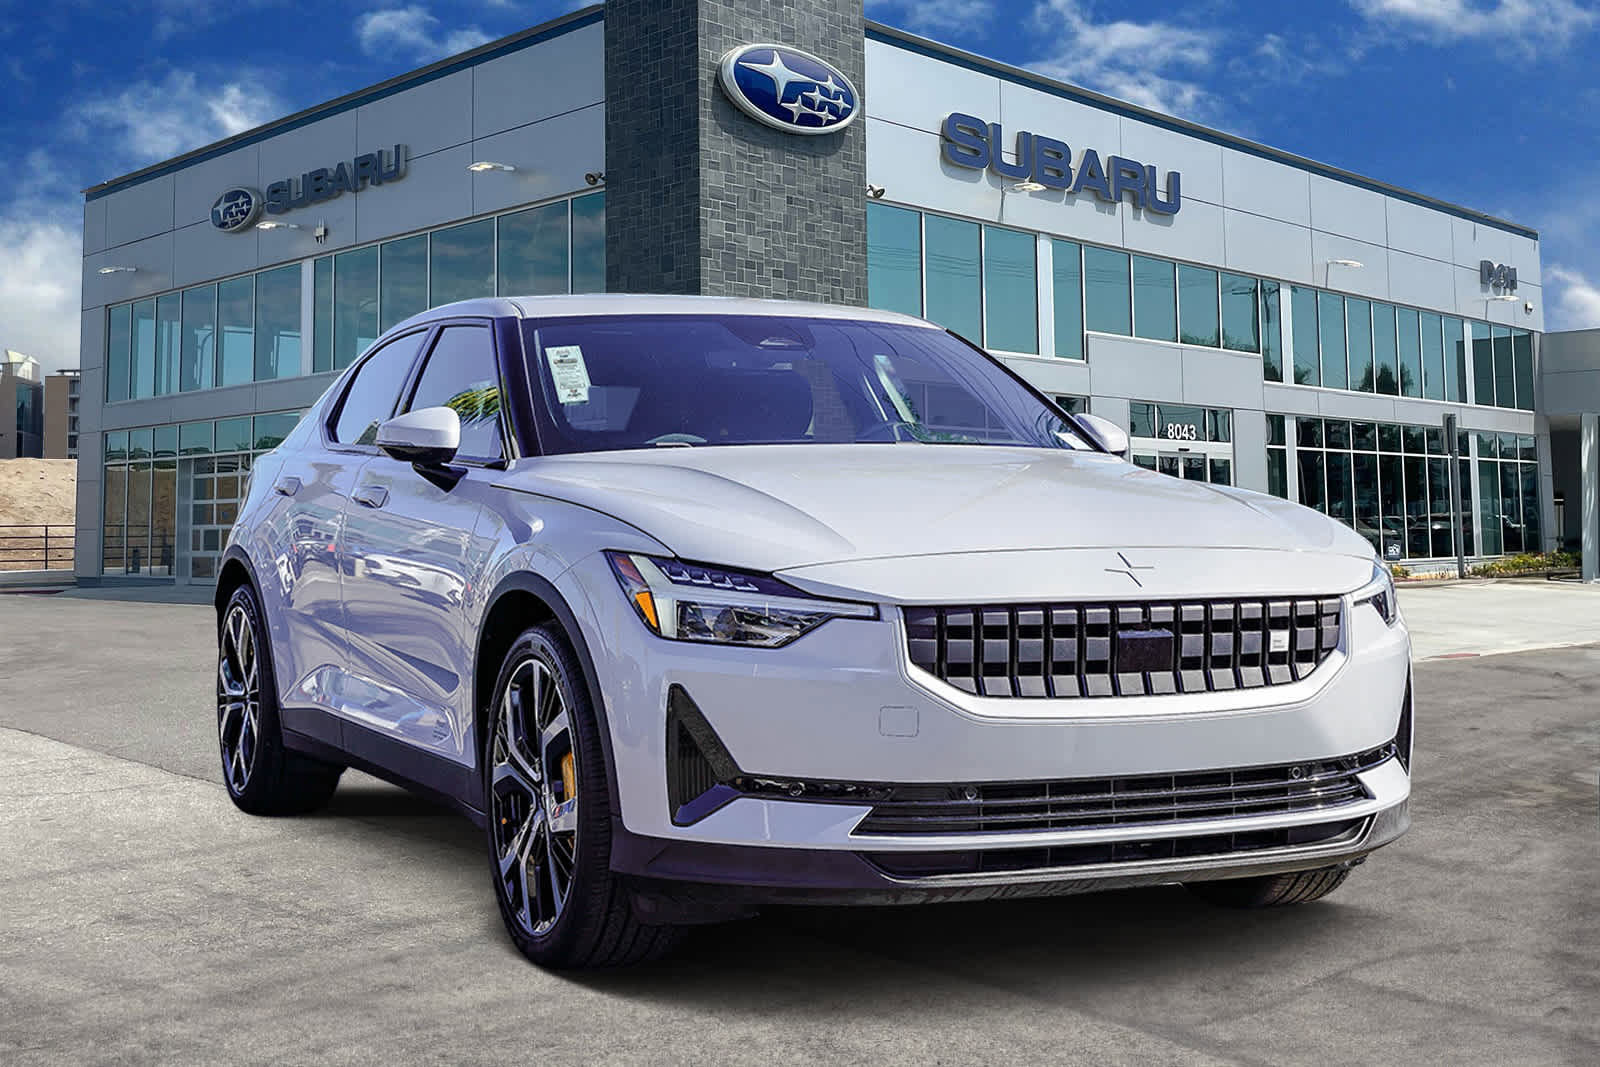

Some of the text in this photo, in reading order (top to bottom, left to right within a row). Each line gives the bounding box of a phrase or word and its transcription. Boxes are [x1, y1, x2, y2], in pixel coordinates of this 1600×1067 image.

[266, 144, 406, 214] SUBARU
[942, 112, 1181, 215] SUBARU
[1167, 423, 1197, 440] 8043
